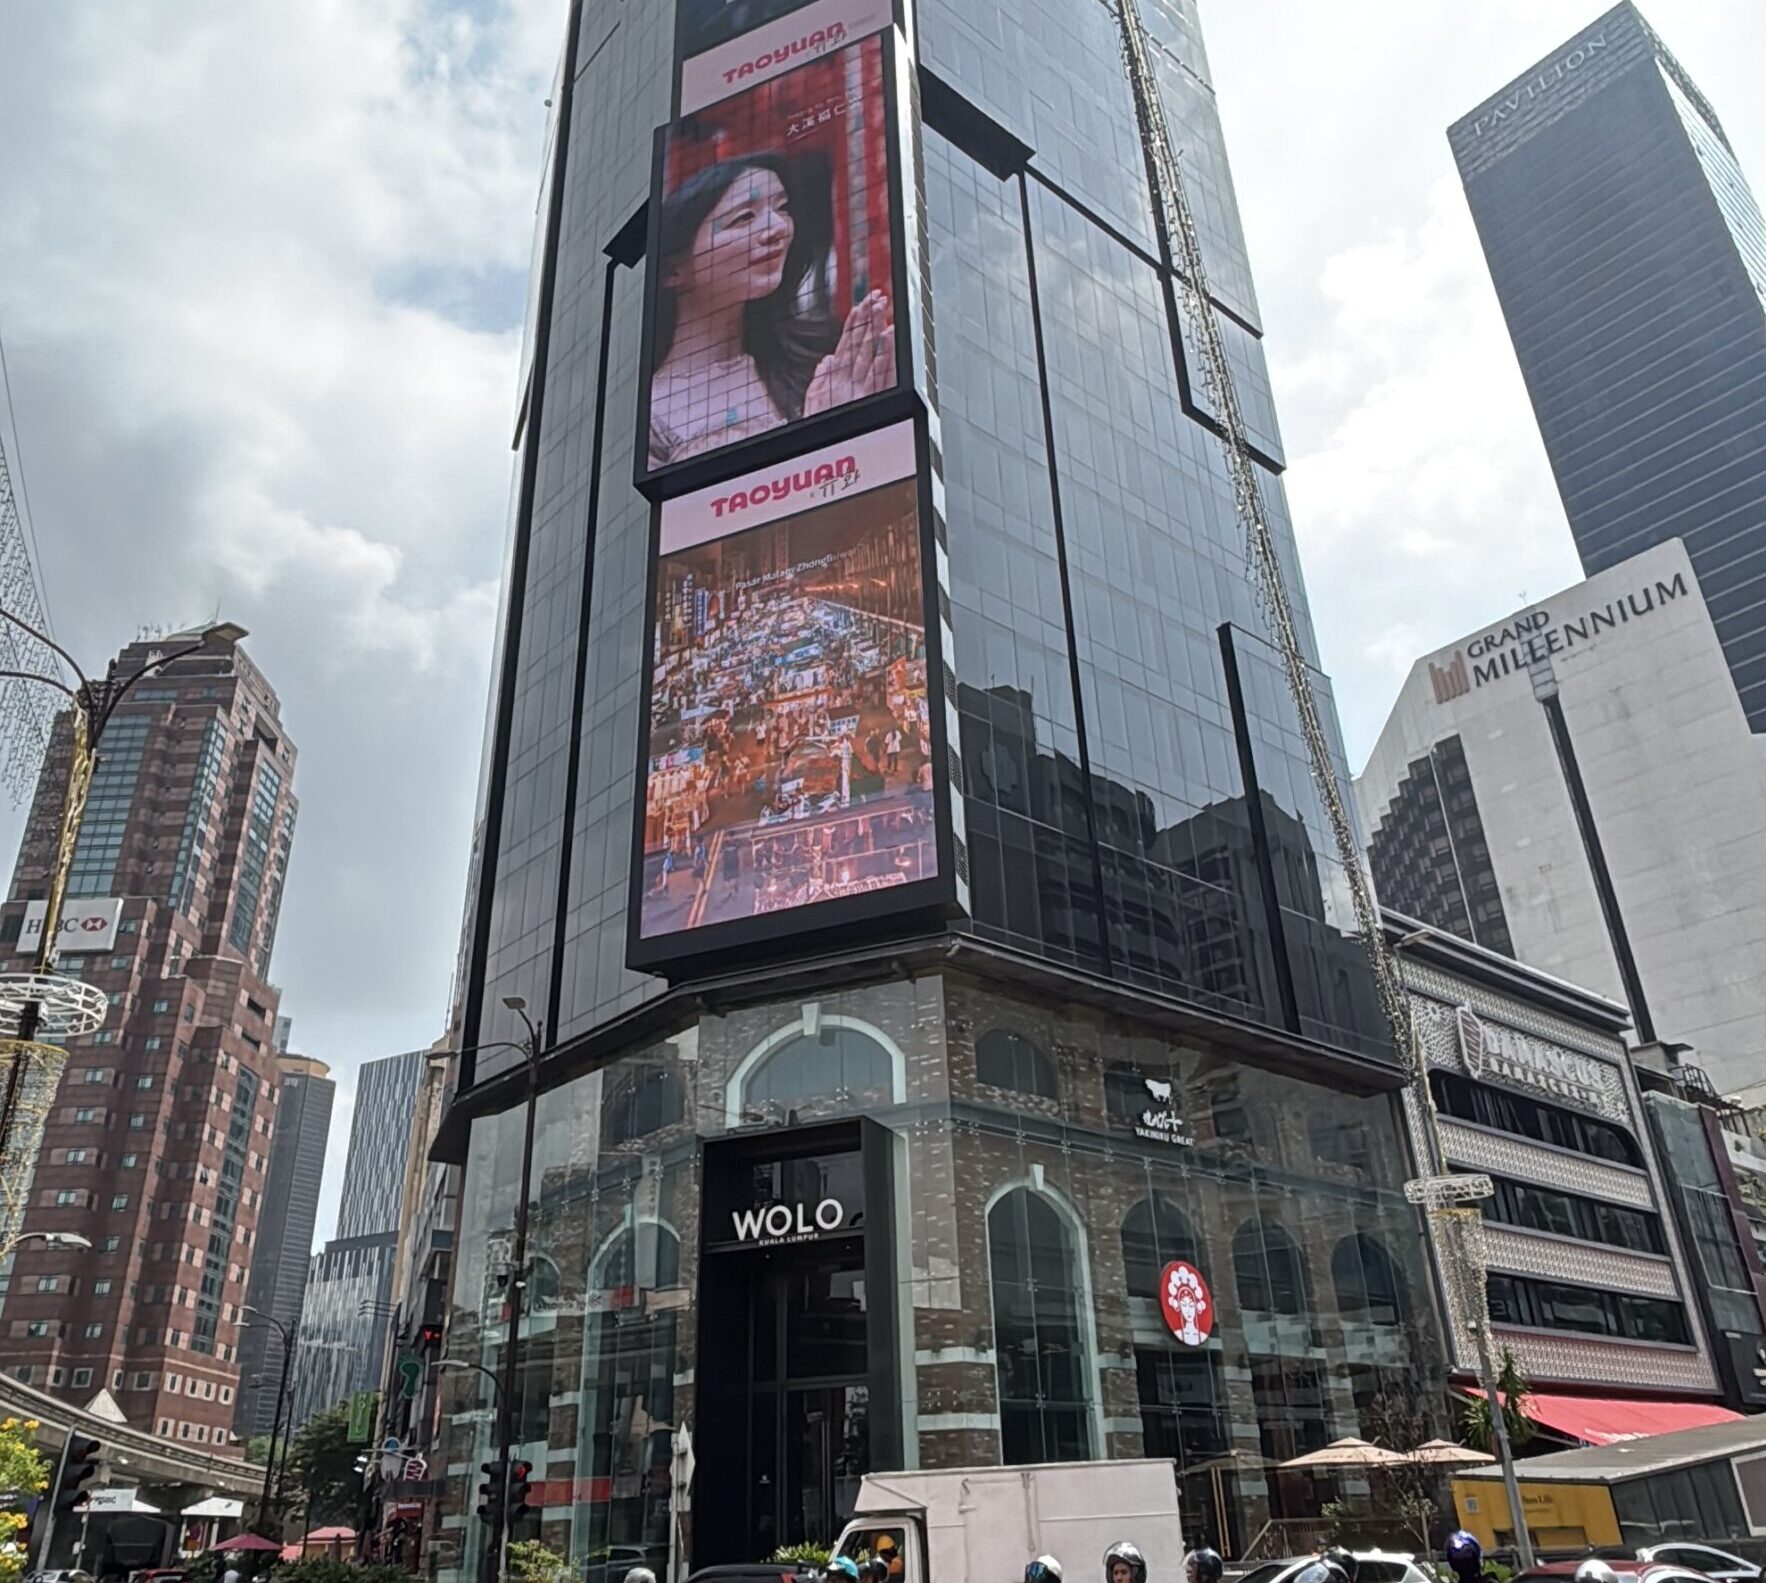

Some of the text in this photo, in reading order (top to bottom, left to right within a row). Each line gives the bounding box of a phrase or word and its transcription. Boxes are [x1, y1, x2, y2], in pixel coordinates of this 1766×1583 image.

[722, 22, 844, 84] TAOYUAN
[1472, 32, 1609, 136] PAVILION
[710, 455, 856, 518] TAOYUAN
[1466, 610, 1551, 660] GRAND
[1472, 572, 1689, 688] MILLENNIUM
[26, 917, 79, 935] HBC
[1171, 1134, 1193, 1146] GREAT
[732, 1198, 844, 1242] WOLO
[758, 1232, 819, 1247] KUALA LUMPUR
